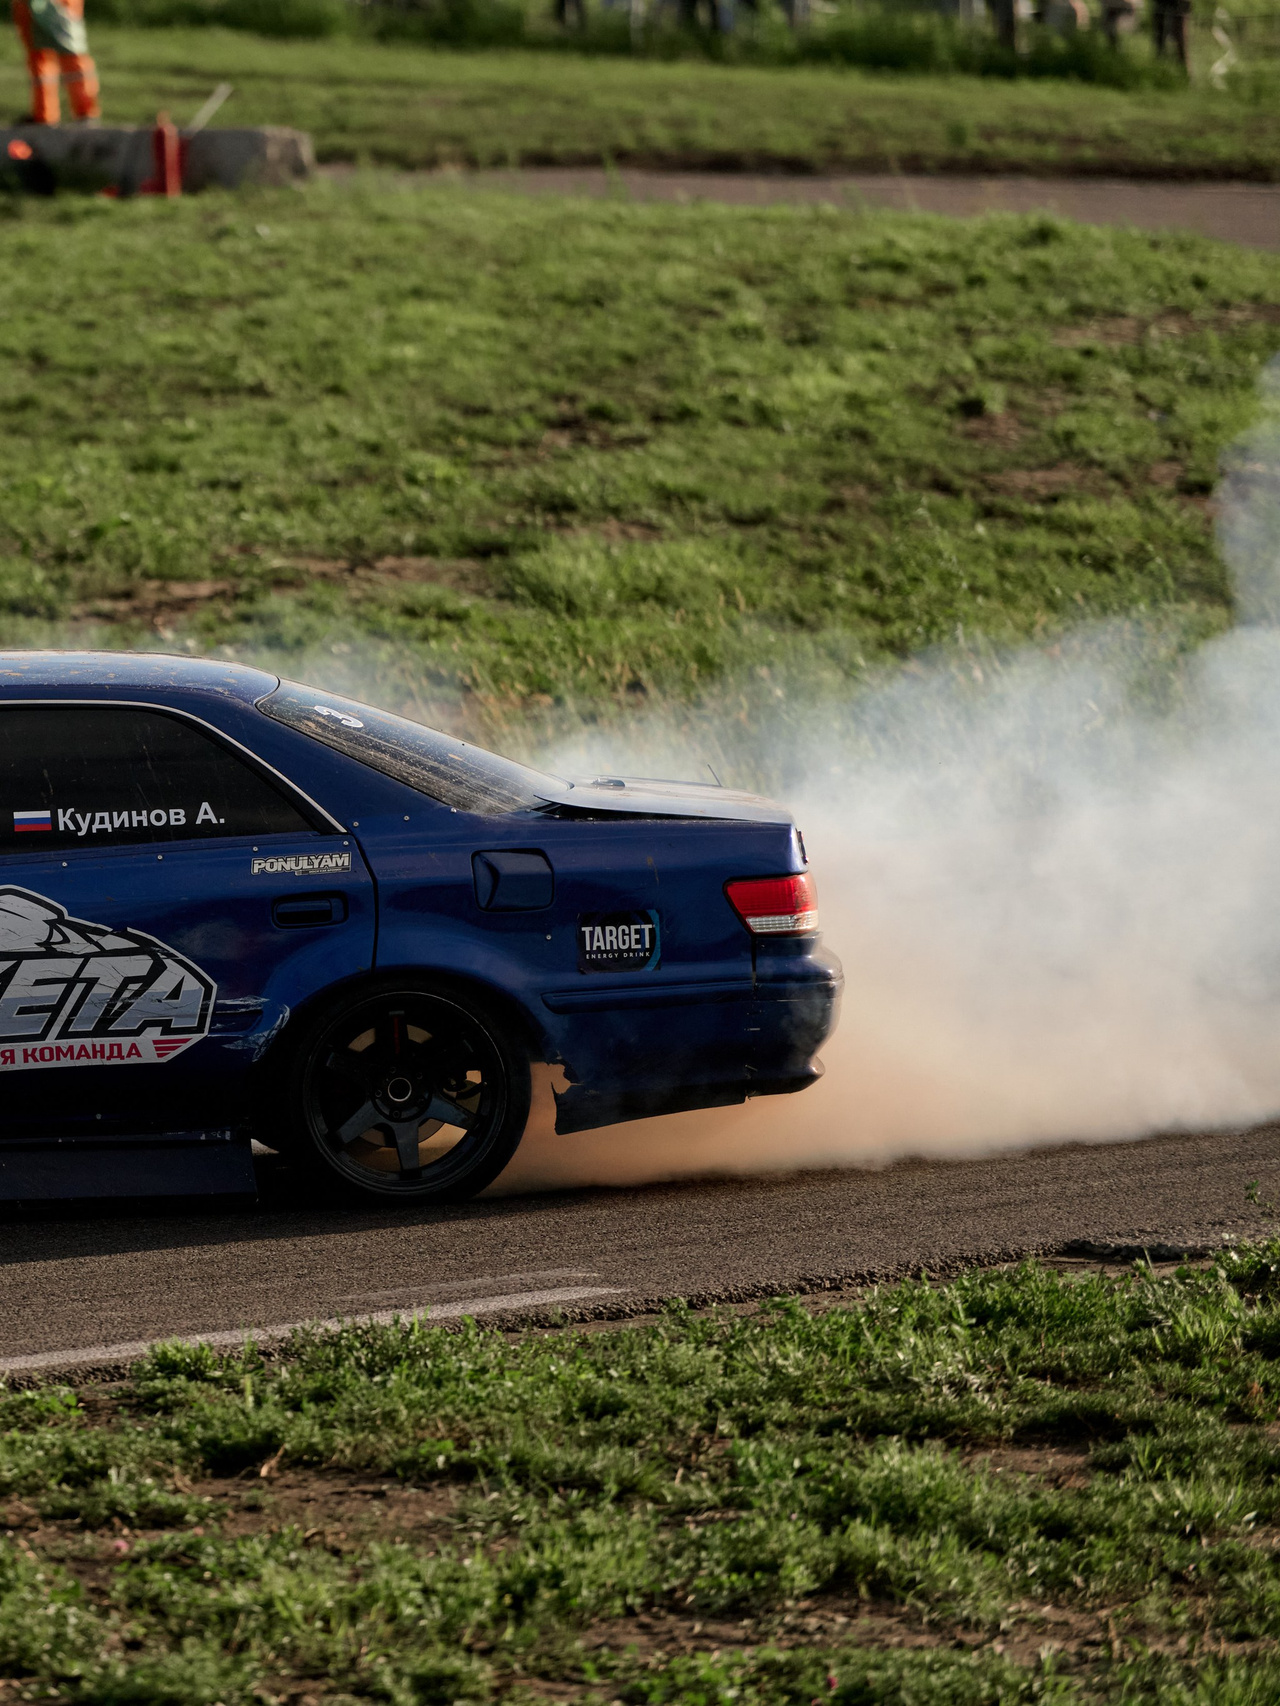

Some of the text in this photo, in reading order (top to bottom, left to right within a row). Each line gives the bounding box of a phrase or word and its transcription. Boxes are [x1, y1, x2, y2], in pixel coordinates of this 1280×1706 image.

[57, 802, 225, 836] Кудинов А.
[253, 853, 350, 874] PONULYAM
[581, 923, 653, 951] TARGET
[22, 1042, 143, 1064] КОМАНДА
